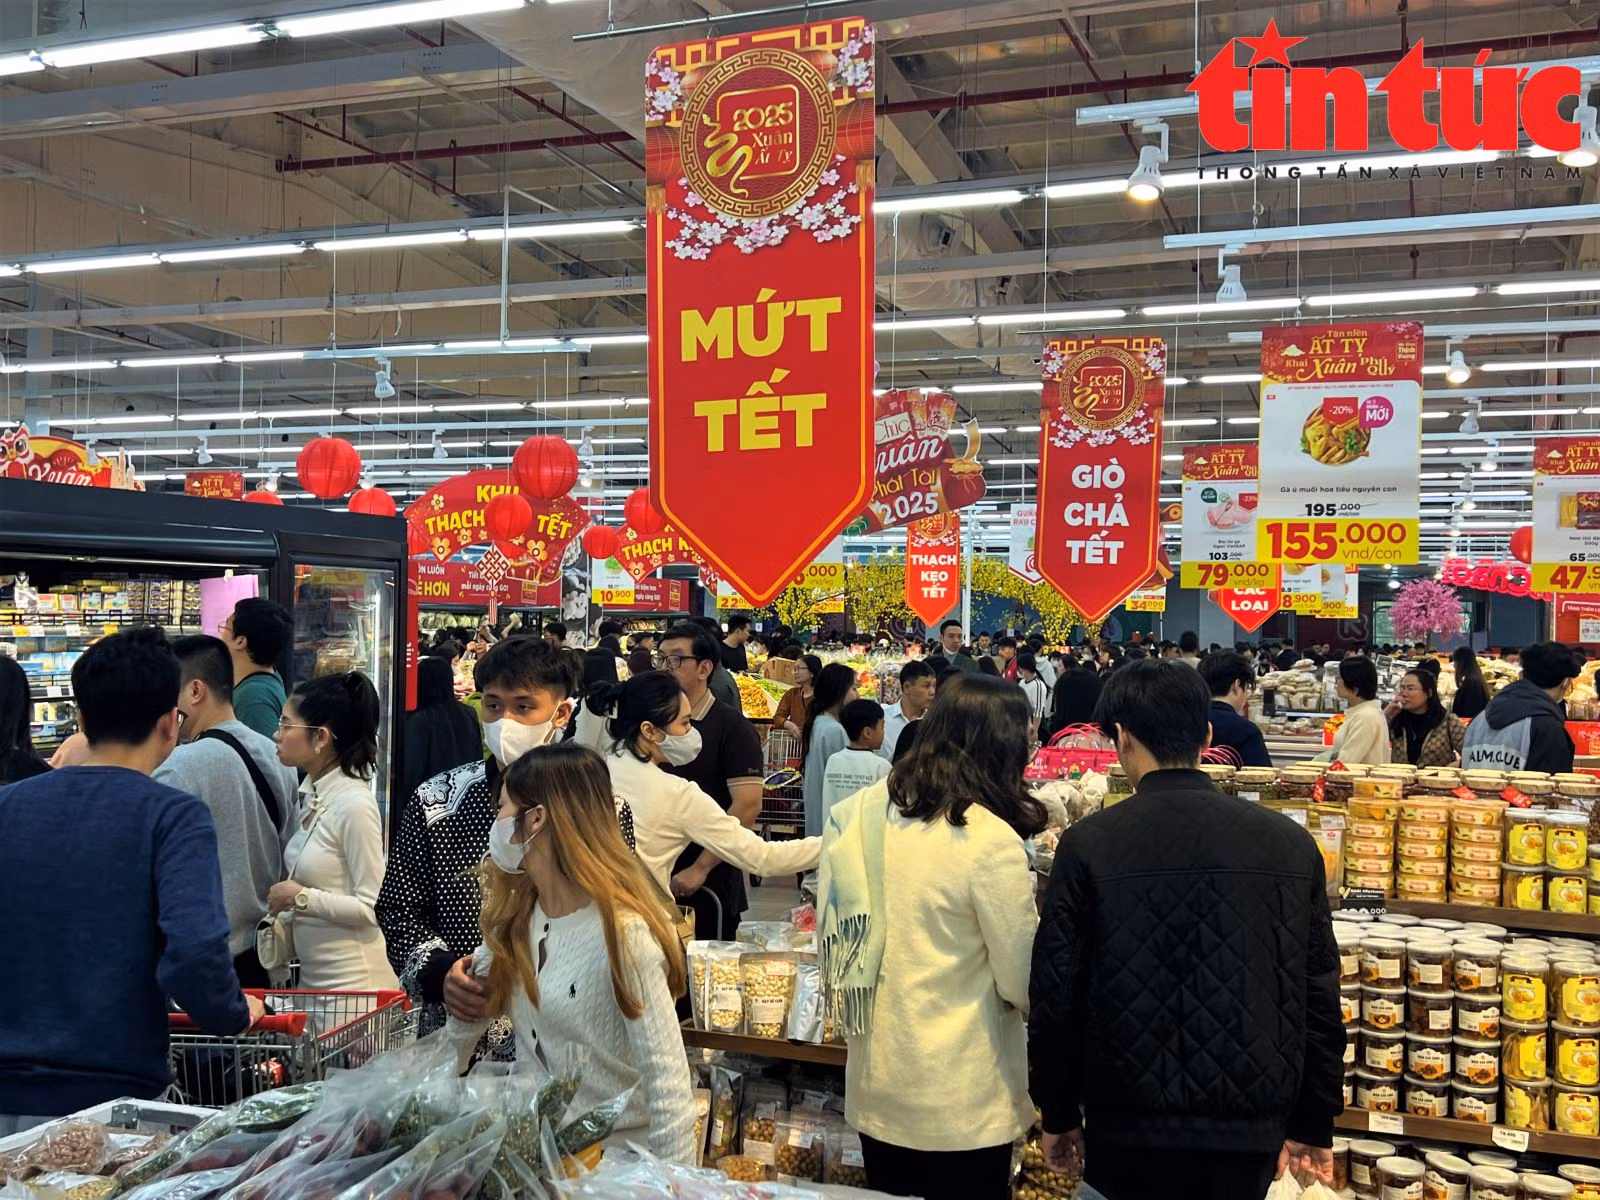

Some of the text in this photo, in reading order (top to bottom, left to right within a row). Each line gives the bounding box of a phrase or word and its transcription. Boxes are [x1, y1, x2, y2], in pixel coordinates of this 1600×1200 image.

[733, 101, 793, 132] 2025
[752, 130, 793, 148] Xuân
[680, 287, 842, 362] MỨT
[1309, 335, 1335, 354] ẤT
[1285, 359, 1308, 368] Khai
[1296, 358, 1357, 381] Xuân
[1089, 374, 1123, 388] 2025
[693, 367, 828, 452] TẾT
[1329, 405, 1354, 415] -20%
[875, 434, 944, 474] uân
[1071, 457, 1126, 489] GIÒ
[1203, 465, 1240, 480] Xuân
[1557, 459, 1599, 474] Xuân
[912, 467, 936, 487] Tài
[1353, 486, 1381, 494] nguyên
[880, 491, 939, 526] 2025
[1063, 493, 1130, 527] CHẢ
[1304, 503, 1361, 516] 195.000
[425, 509, 486, 535] THẠCH
[537, 512, 573, 539] TẾT
[1066, 530, 1125, 565] TẾT
[1266, 522, 1407, 560] 155.000
[911, 554, 957, 569] THẠCH
[1342, 545, 1402, 560] vnd/con
[427, 566, 445, 575] LUÔN
[920, 570, 949, 585] KẸO
[1198, 563, 1269, 586] 79.000
[424, 582, 450, 597] HƠN
[921, 582, 948, 598] TẾT
[1233, 577, 1264, 586] vnd/kg
[1231, 600, 1269, 614] LOẠI
